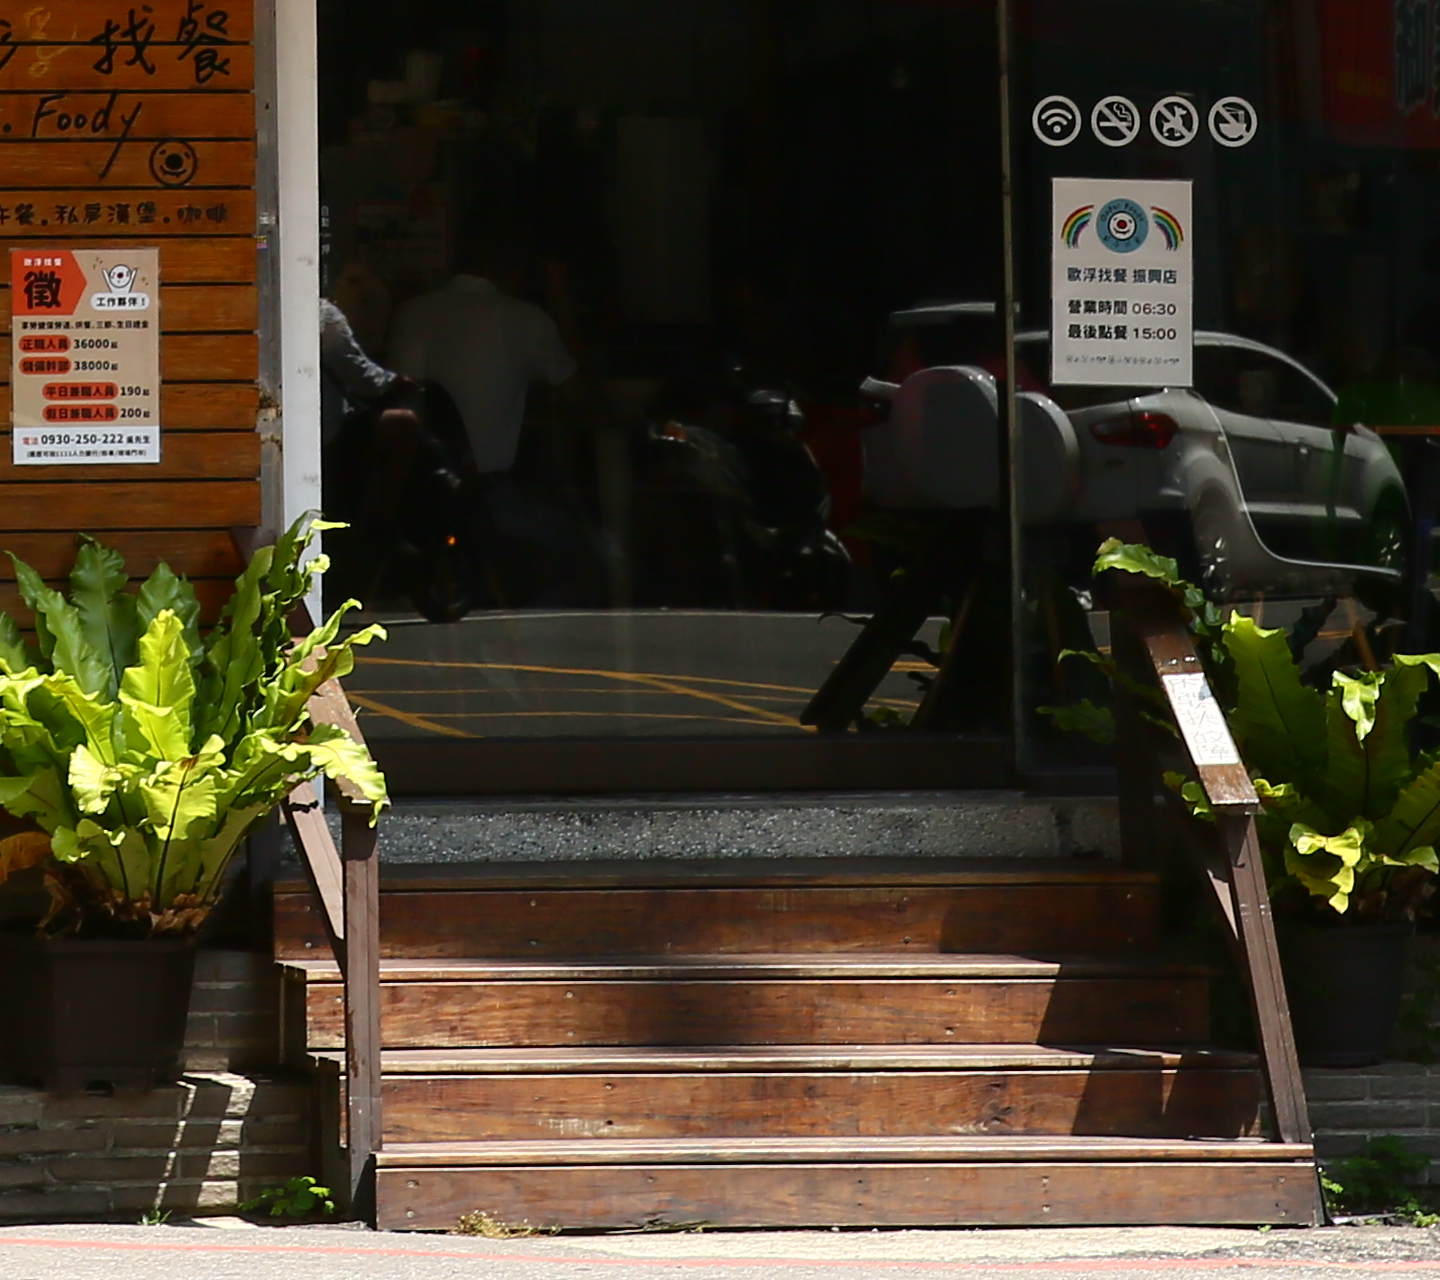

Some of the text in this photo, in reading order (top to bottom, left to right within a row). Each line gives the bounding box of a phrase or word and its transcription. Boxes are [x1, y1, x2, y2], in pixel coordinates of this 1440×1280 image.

[31, 90, 144, 184] Foody
[1132, 268, 1178, 285] 振興店
[23, 269, 62, 310] 徵
[1067, 299, 1177, 316] 營業時間 06:30
[1067, 324, 1177, 340] 最後點餐 15:00
[40, 434, 124, 445] 0930-250-222
